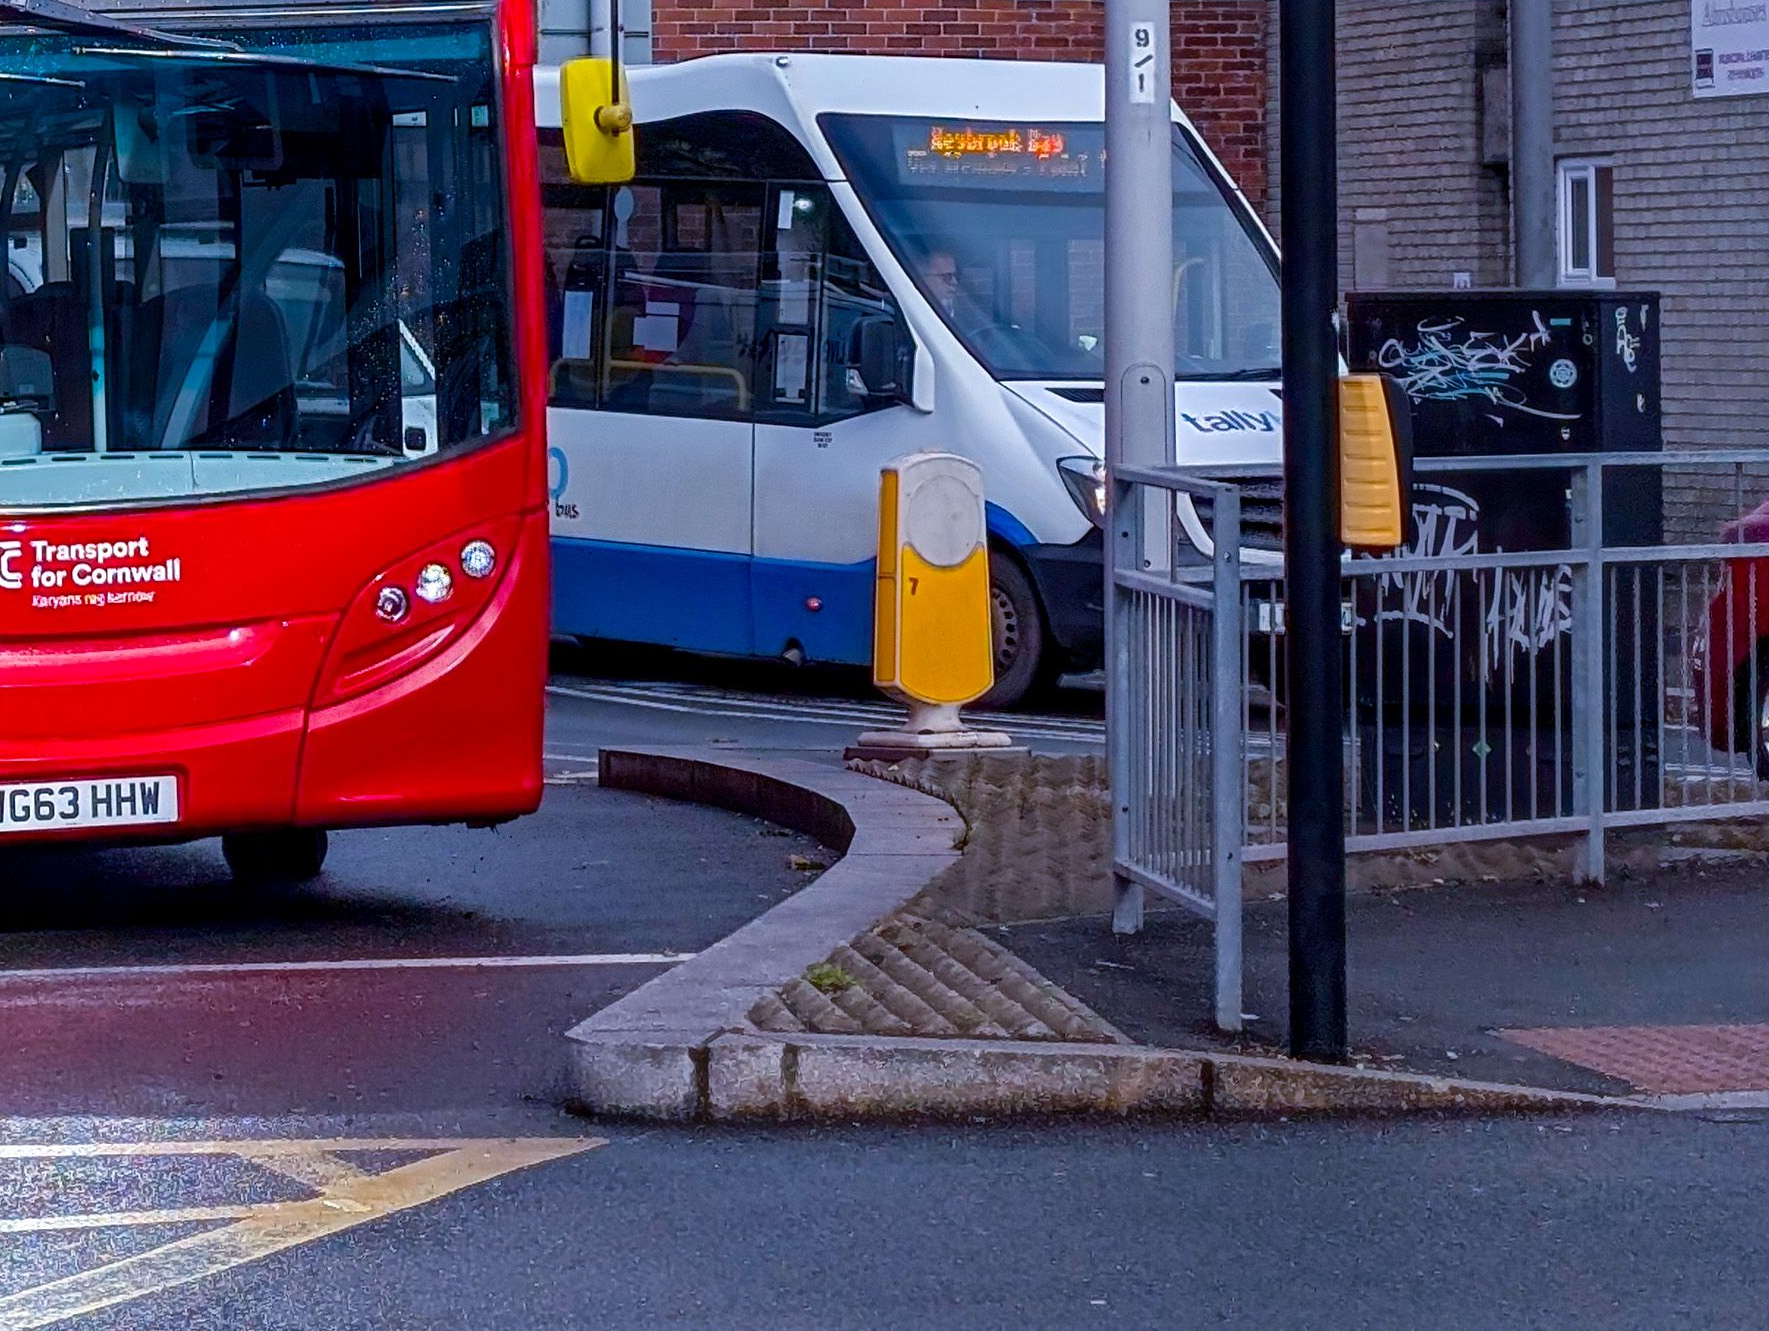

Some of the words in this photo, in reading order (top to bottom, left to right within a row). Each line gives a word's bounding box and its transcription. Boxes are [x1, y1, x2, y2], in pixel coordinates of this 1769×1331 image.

[555, 495, 580, 519] bus
[29, 537, 149, 563] Transport
[31, 564, 67, 588] for
[72, 558, 181, 586] Cornwall
[908, 576, 919, 596] 7
[90, 781, 160, 818] HHW
